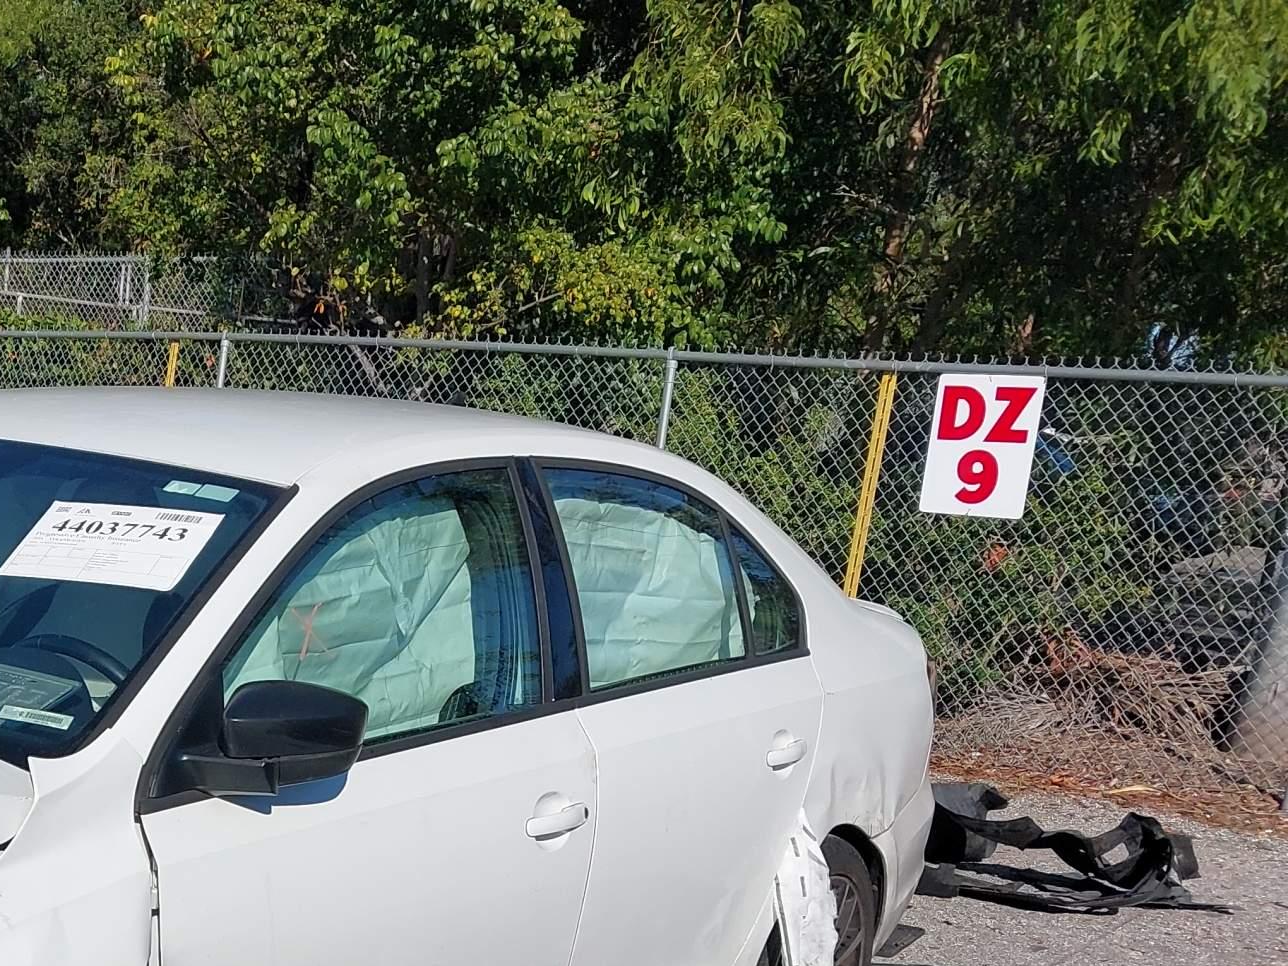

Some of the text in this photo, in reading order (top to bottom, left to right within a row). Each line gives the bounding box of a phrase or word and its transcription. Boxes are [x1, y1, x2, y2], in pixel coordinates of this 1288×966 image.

[937, 385, 1038, 443] DZ
[954, 449, 999, 504] 9
[52, 518, 189, 542] 44037743
